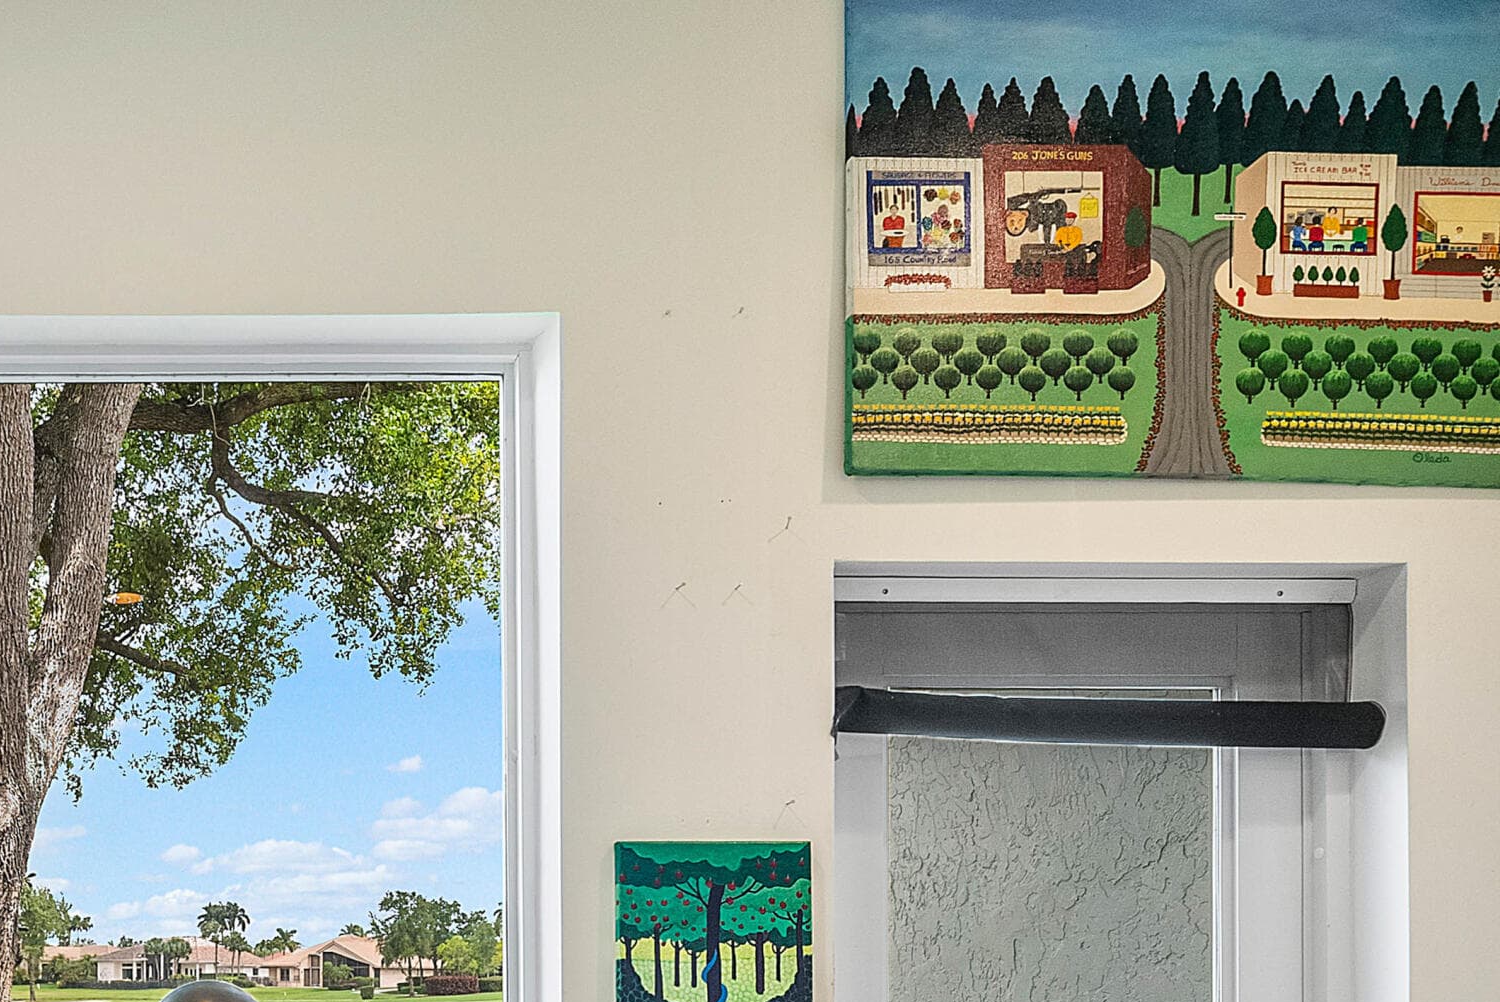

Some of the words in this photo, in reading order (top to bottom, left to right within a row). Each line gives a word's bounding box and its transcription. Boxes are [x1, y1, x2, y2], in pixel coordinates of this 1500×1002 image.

[1011, 151, 1029, 160] 206
[1066, 151, 1094, 160] GUNS
[883, 255, 901, 264] 165
[902, 255, 935, 265] Country
